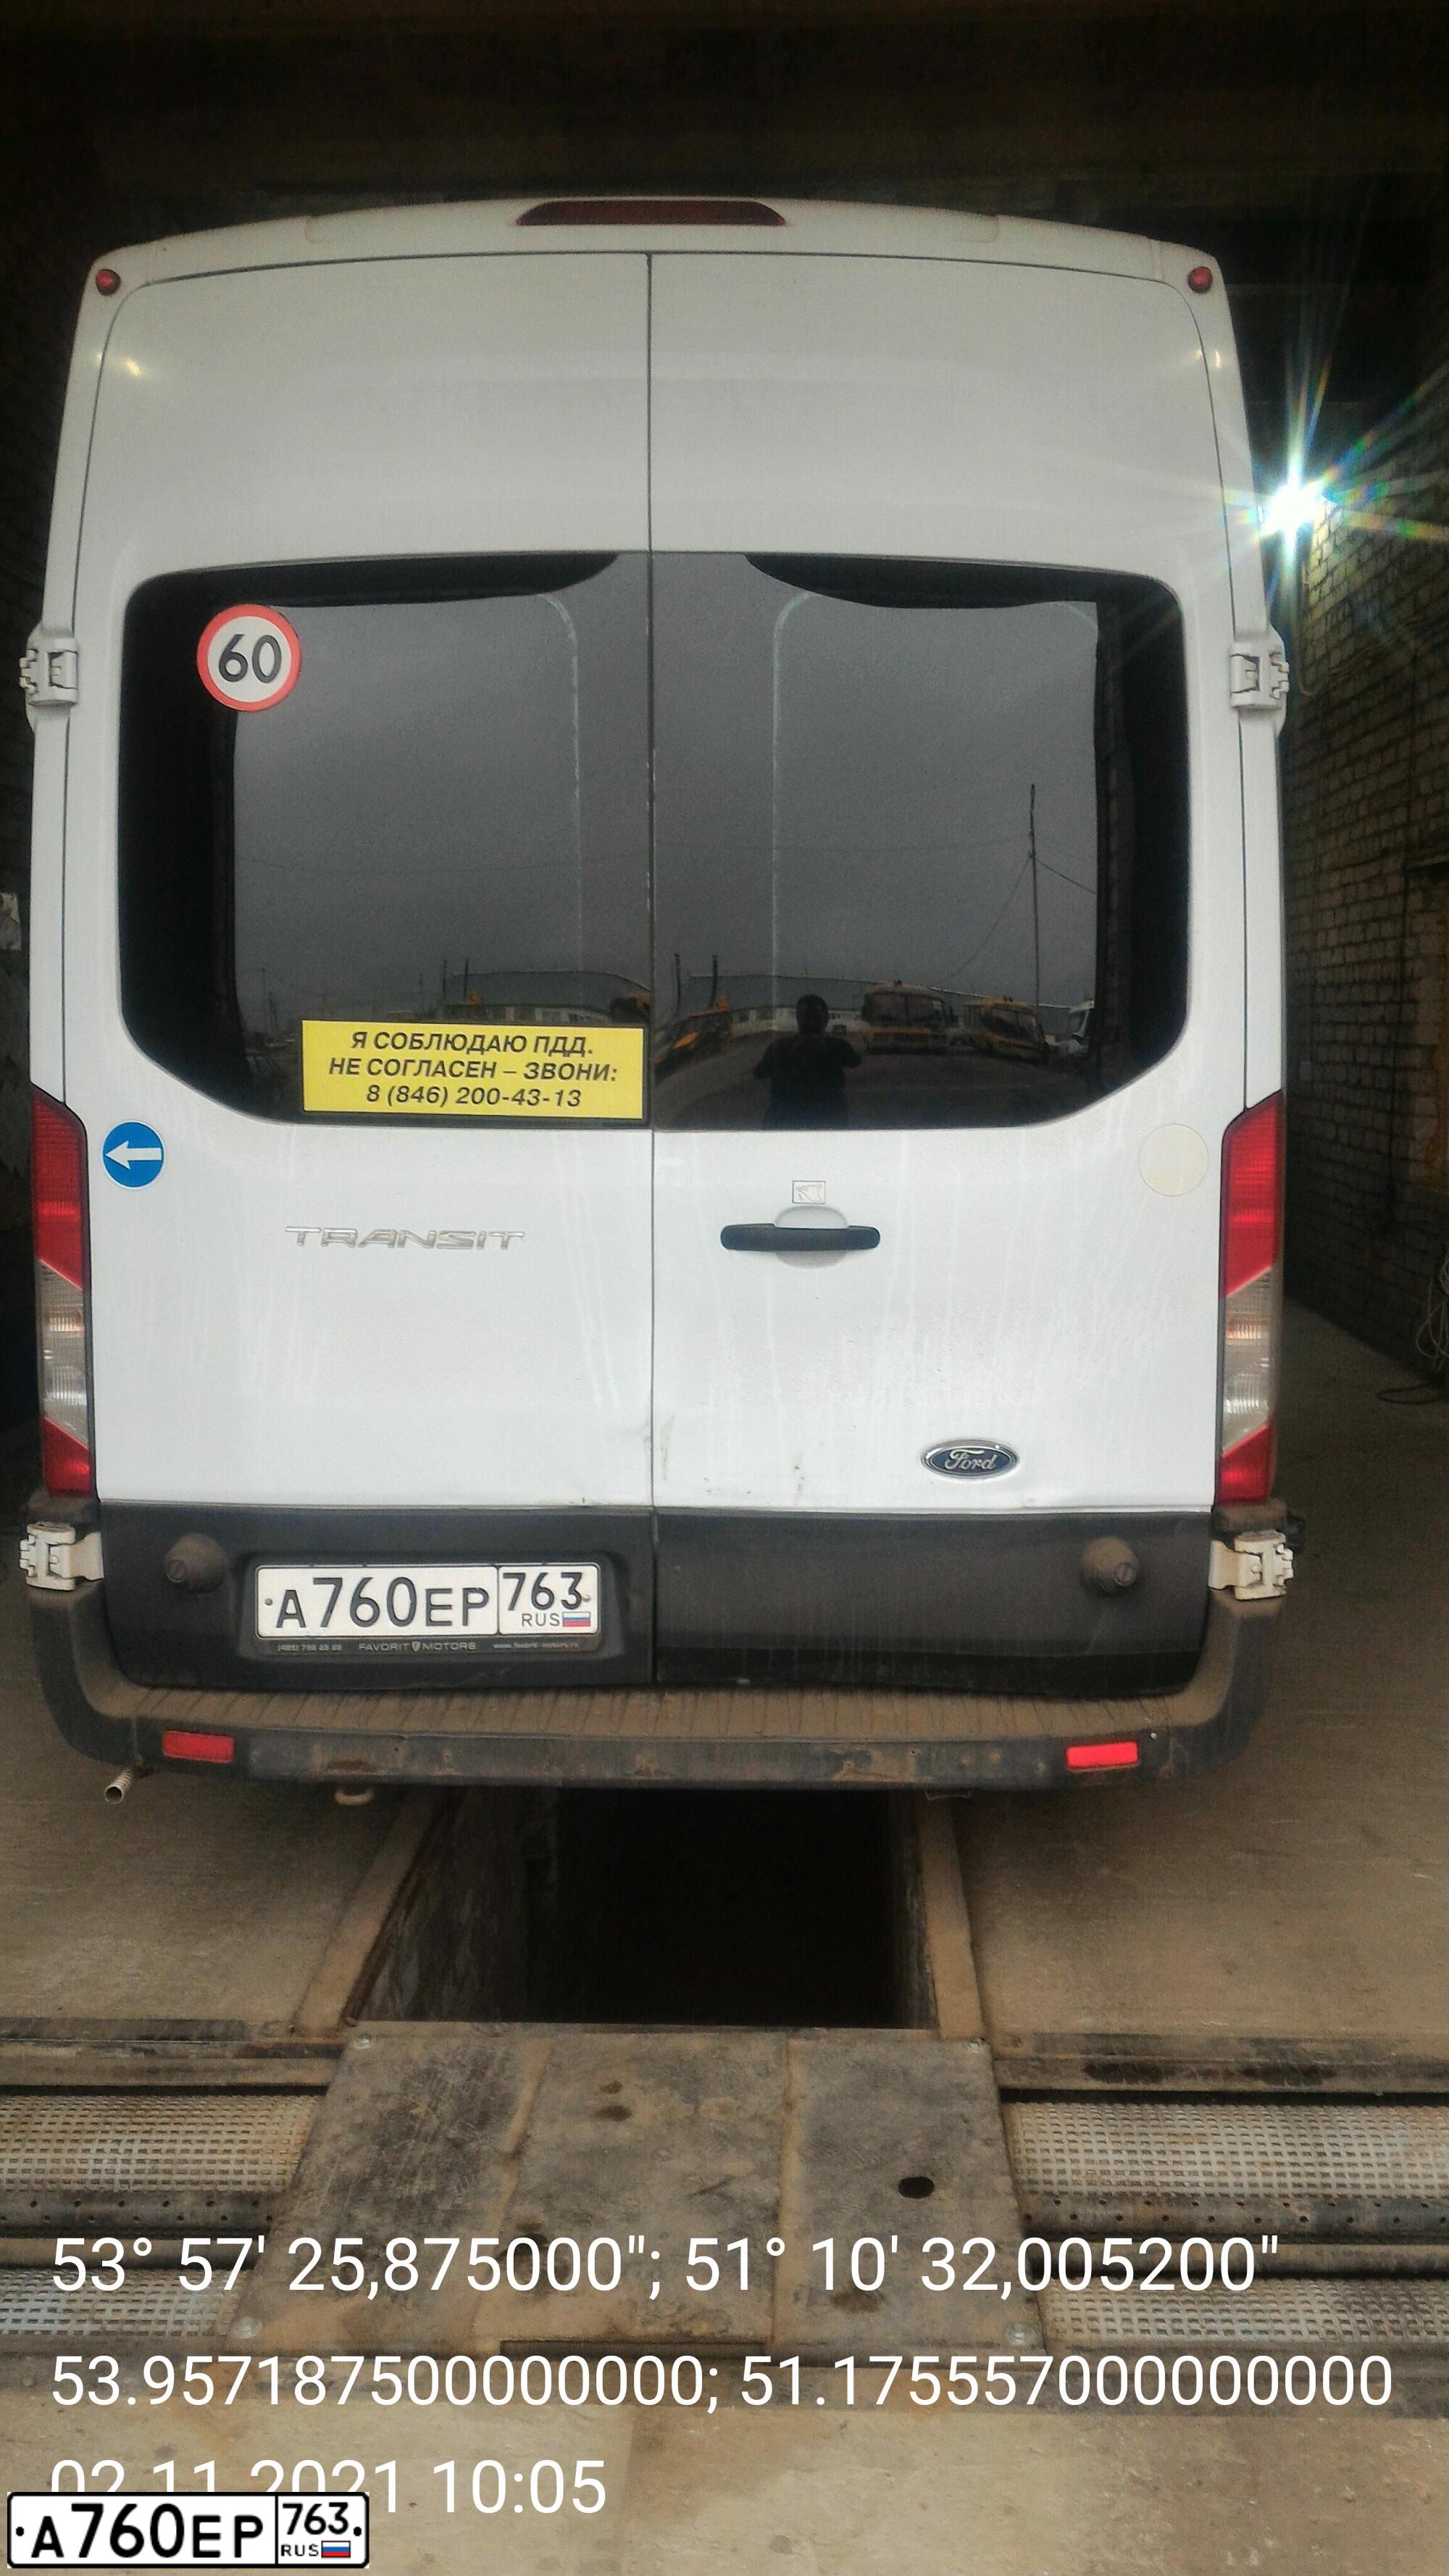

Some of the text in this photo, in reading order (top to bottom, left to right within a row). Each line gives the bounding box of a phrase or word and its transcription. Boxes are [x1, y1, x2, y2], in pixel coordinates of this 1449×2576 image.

[219, 633, 282, 683] 60
[351, 1031, 594, 1057] Я СОБЛЮДАЮ ПДД.
[328, 1058, 362, 1076] НЕ
[367, 1059, 497, 1079] СОГЛАСЕН
[523, 1062, 618, 1082] ЗВОНИ:
[366, 1085, 582, 1108] 8 (846) 200-43-13
[285, 1226, 525, 1251] TRANSIT
[943, 1449, 998, 1471] Ford
[502, 1572, 584, 1611] 763
[521, 1613, 561, 1627] RUS
[358, 1641, 477, 1652] FAVORIT MOTORS
